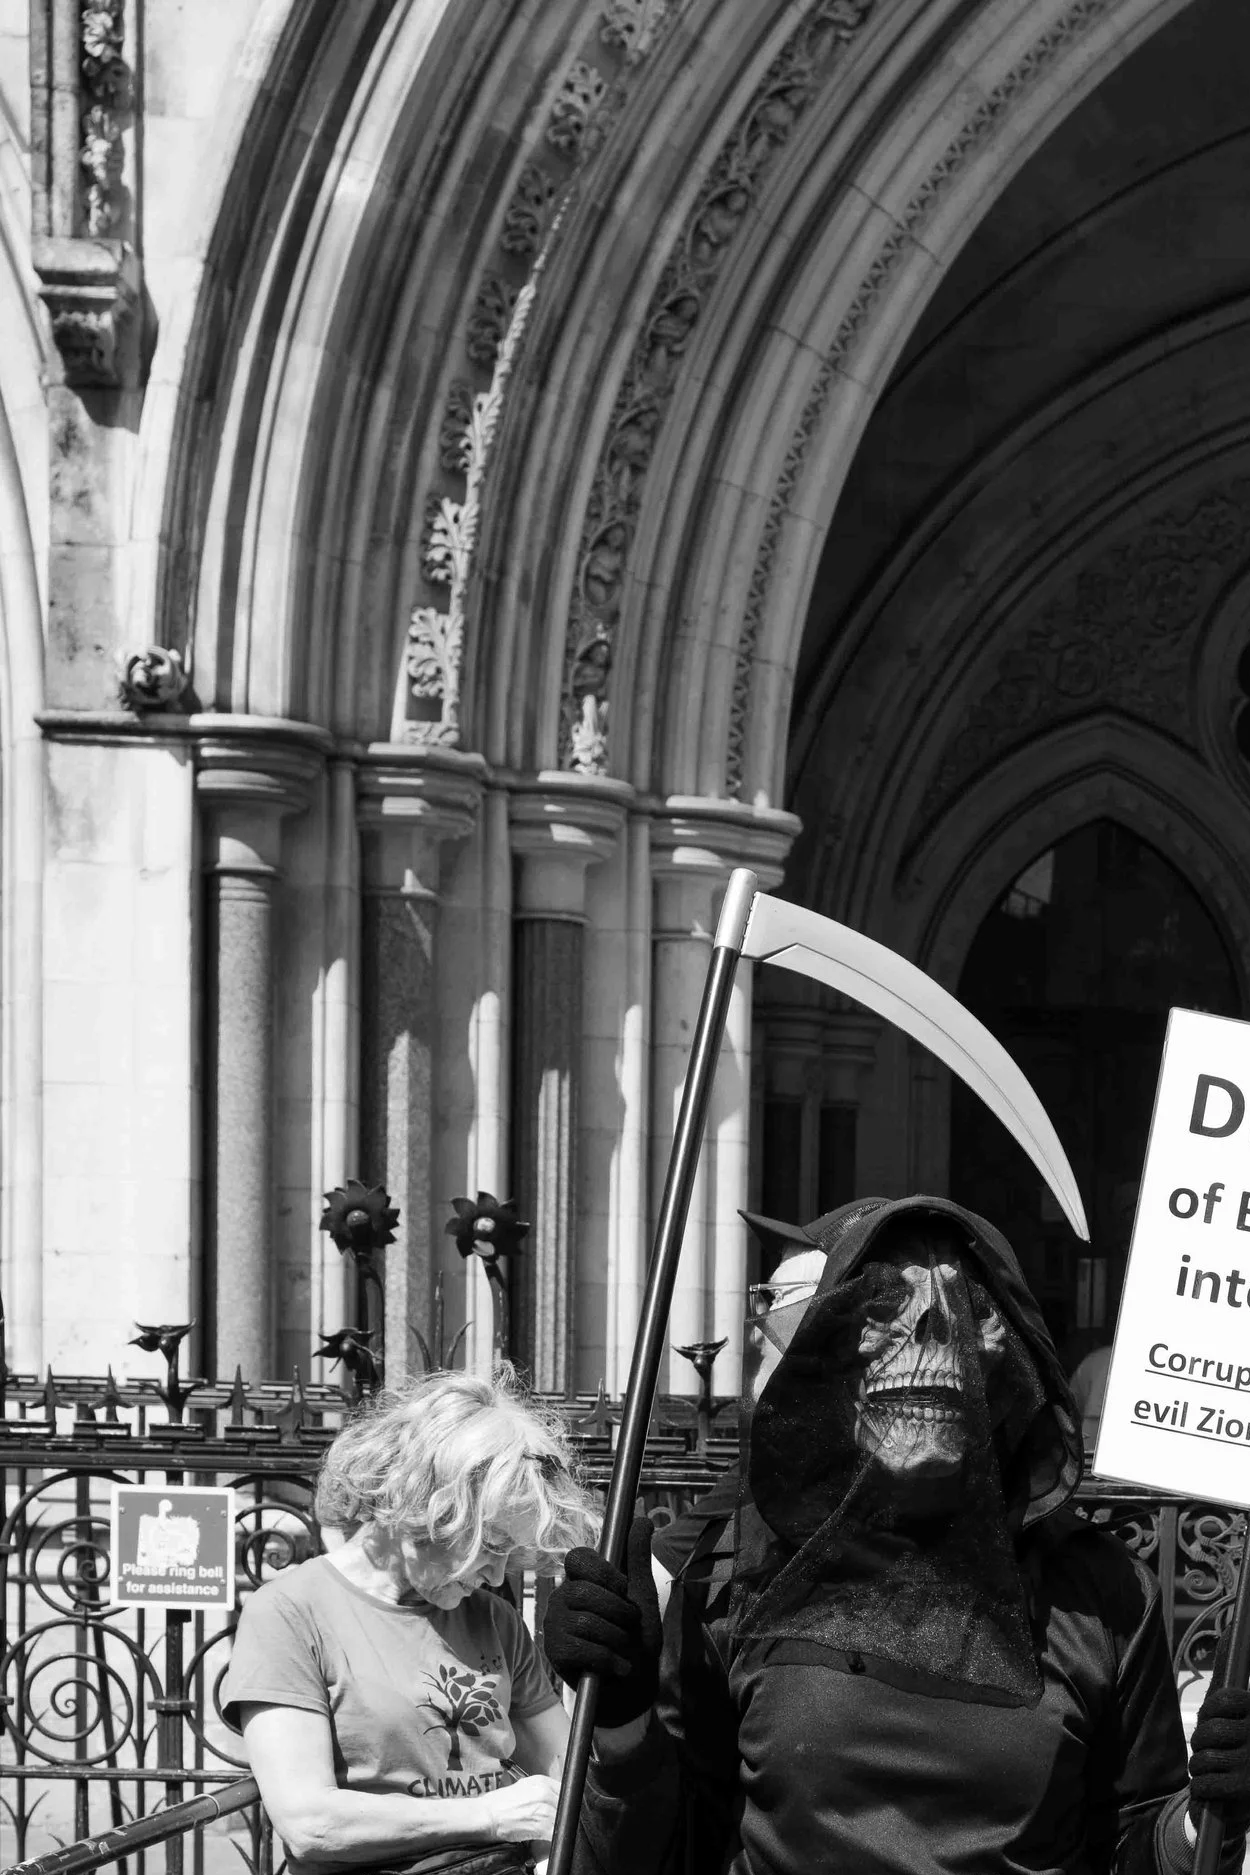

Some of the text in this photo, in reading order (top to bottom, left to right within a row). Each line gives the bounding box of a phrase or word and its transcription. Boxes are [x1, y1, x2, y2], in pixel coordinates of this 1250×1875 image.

[1169, 1183, 1225, 1223] of
[1135, 1400, 1188, 1427] evil
[122, 1563, 224, 1580] Please ring bell
[126, 1580, 219, 1596] for assistance
